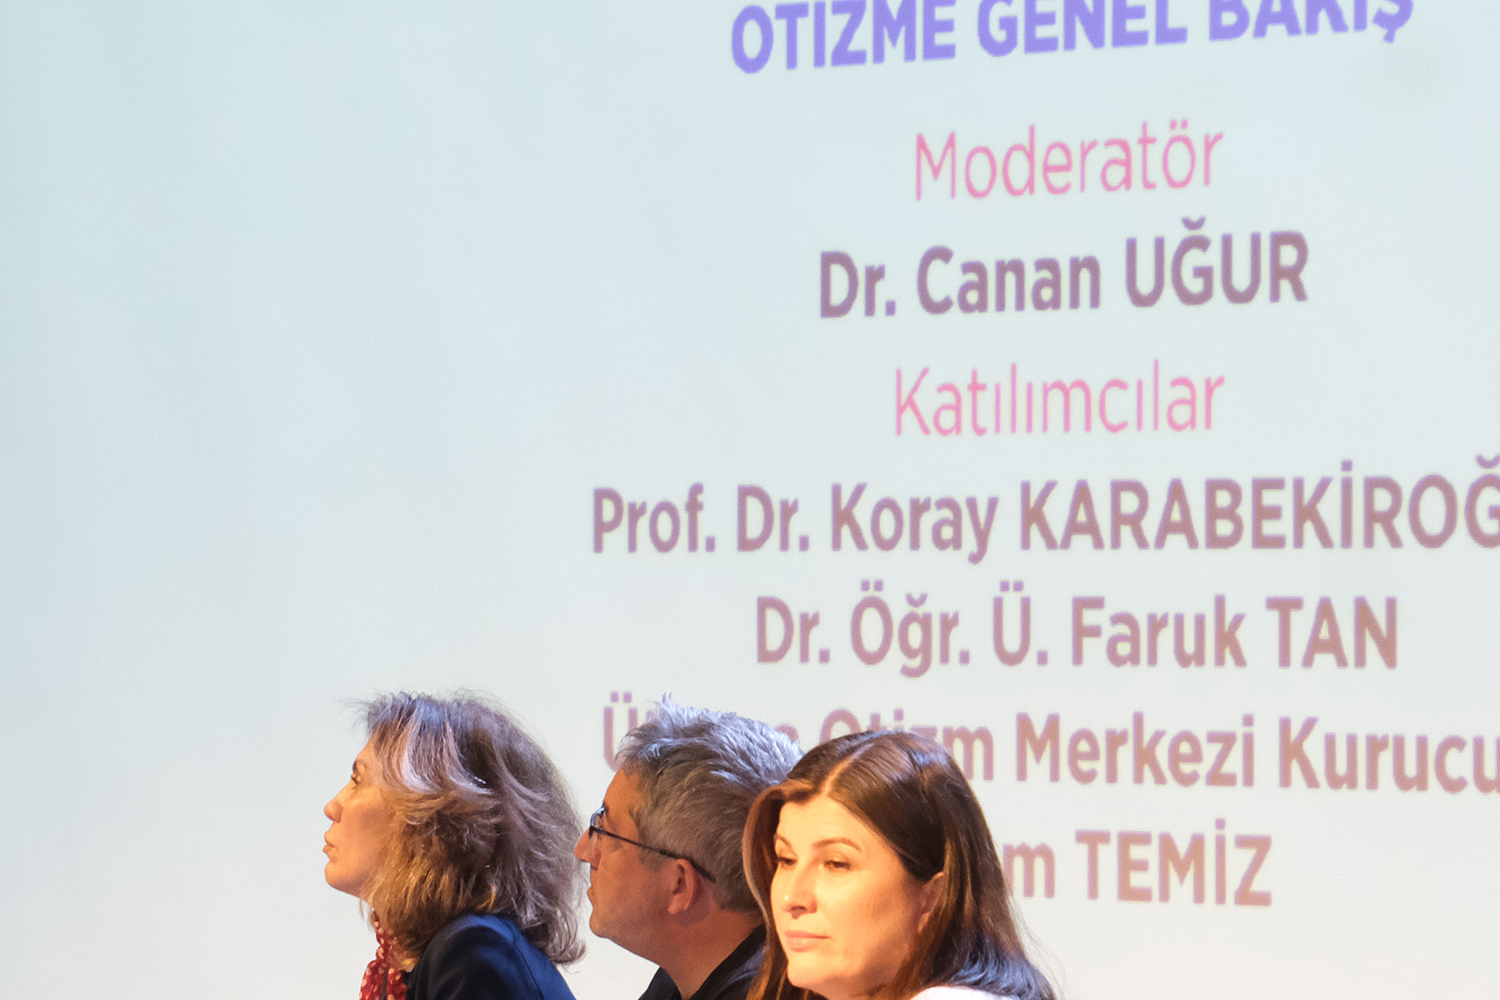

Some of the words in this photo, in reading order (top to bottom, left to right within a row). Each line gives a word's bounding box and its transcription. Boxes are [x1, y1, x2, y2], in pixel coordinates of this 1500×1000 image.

[977, 0, 1188, 57] GENEL
[916, 119, 1223, 201] Moderatör
[820, 250, 896, 319] Dr.
[916, 246, 1101, 315] Canan
[1125, 216, 1309, 308] UĞUR
[896, 359, 1225, 437] Katılımcılar
[593, 482, 716, 554] Prof.
[737, 484, 810, 552] Dr.
[831, 483, 999, 565] Koray
[756, 596, 830, 664] Dr.
[850, 579, 970, 678] Öğr.
[993, 580, 1048, 667] Ü.
[1072, 594, 1247, 668] Faruk
[1265, 596, 1397, 669] TAN
[1016, 711, 1254, 788] Merkezi
[1279, 717, 1500, 794] Kurucu
[1075, 818, 1272, 907] TEMİZ
